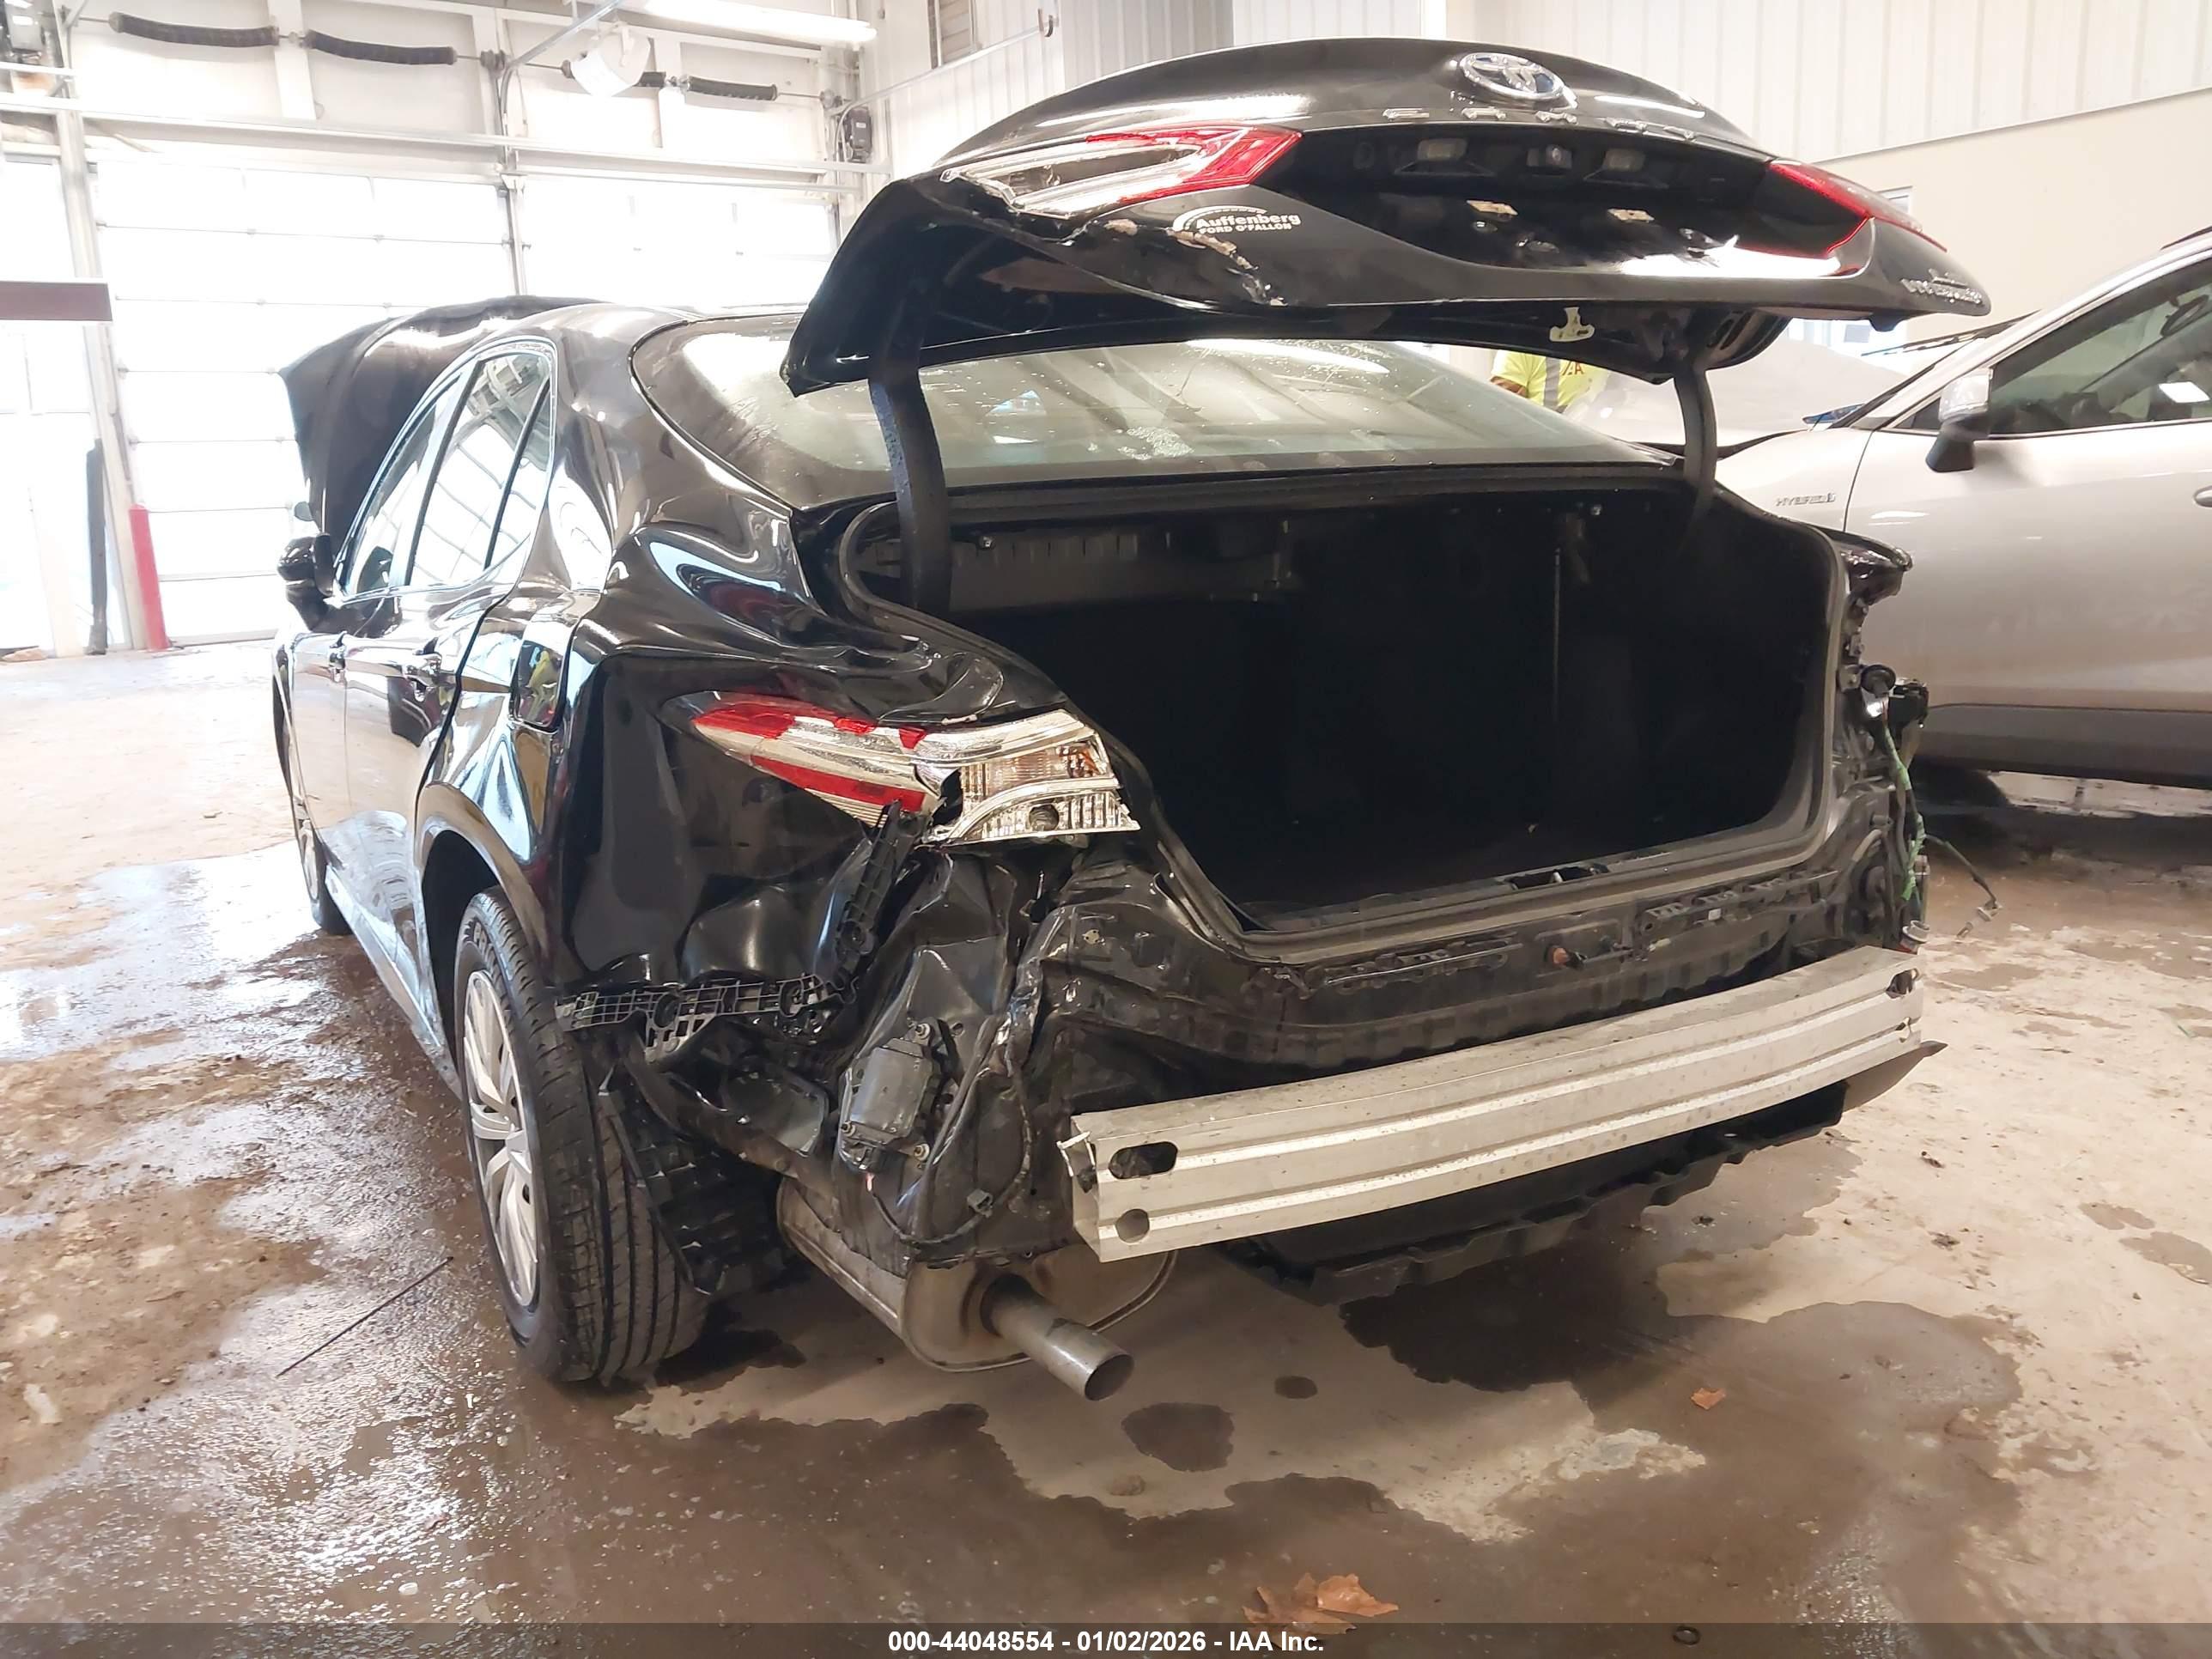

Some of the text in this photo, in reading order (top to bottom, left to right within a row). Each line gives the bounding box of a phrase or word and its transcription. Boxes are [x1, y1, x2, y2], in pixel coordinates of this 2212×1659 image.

[1196, 214, 1301, 228] Auffenberg
[1199, 223, 1292, 234] FORD O'FALLON
[1775, 492, 1835, 507] HYBRID
